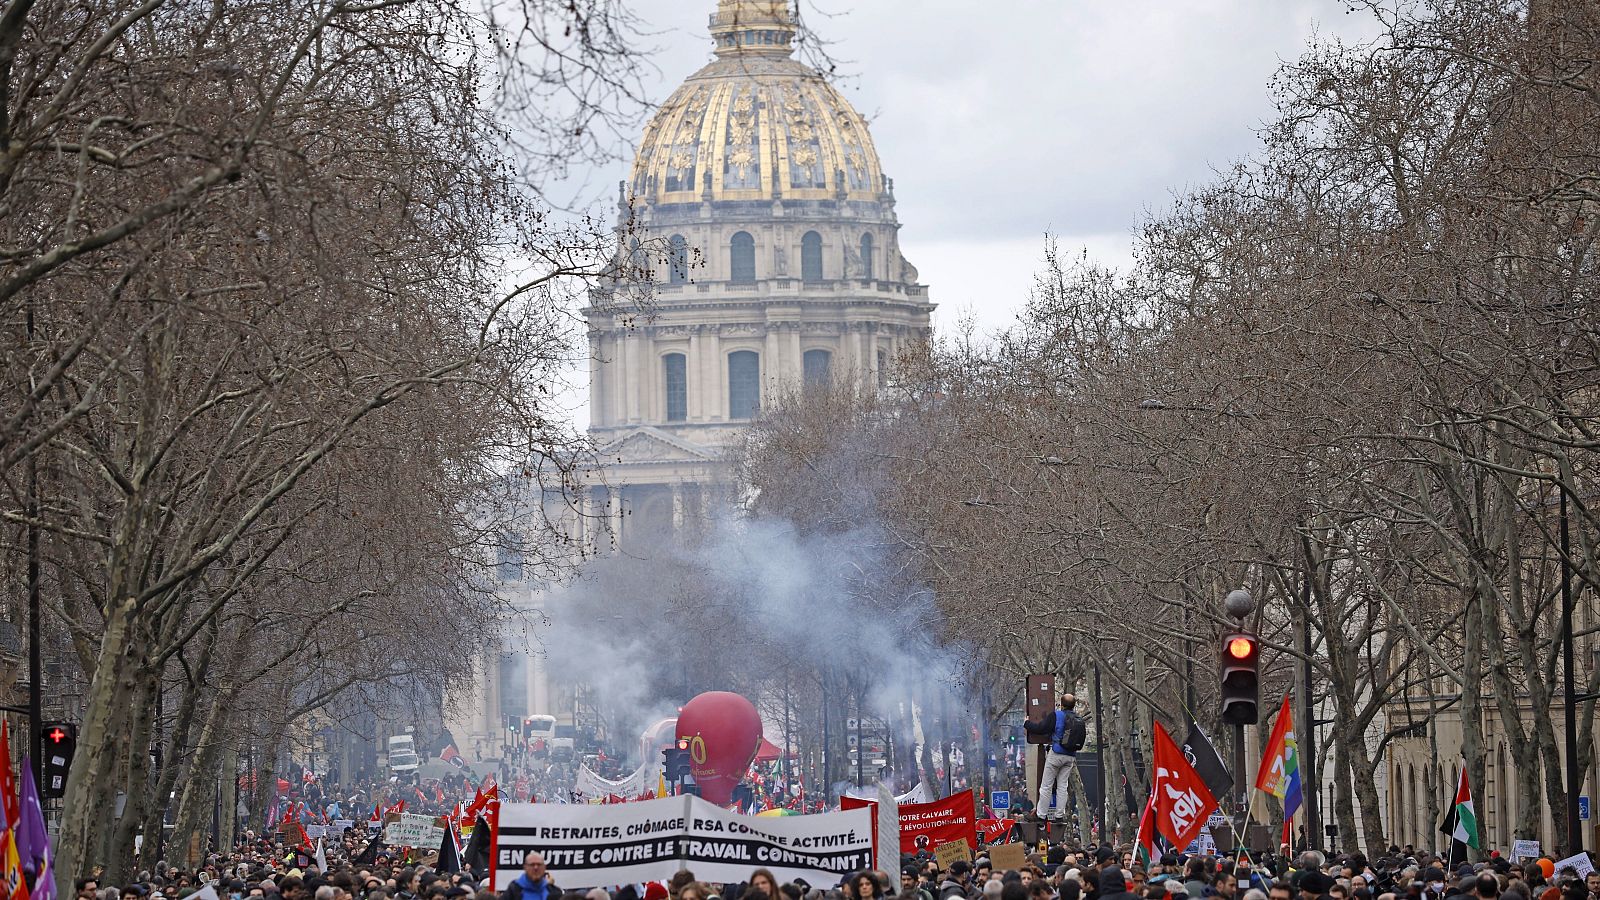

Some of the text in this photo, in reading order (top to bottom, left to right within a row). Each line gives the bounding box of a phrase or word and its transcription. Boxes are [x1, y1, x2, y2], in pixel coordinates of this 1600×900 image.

[904, 816, 967, 831] RÉVOLUTIONNAIRE
[921, 808, 953, 819] CALVAIRE
[540, 818, 869, 848] RETRAITES, CHÔMAGE, RSA CONTRE ACTIVITÉ...
[499, 841, 870, 871] EN UTTE CONTRE LE TRAVAIL CONTRAINT !
